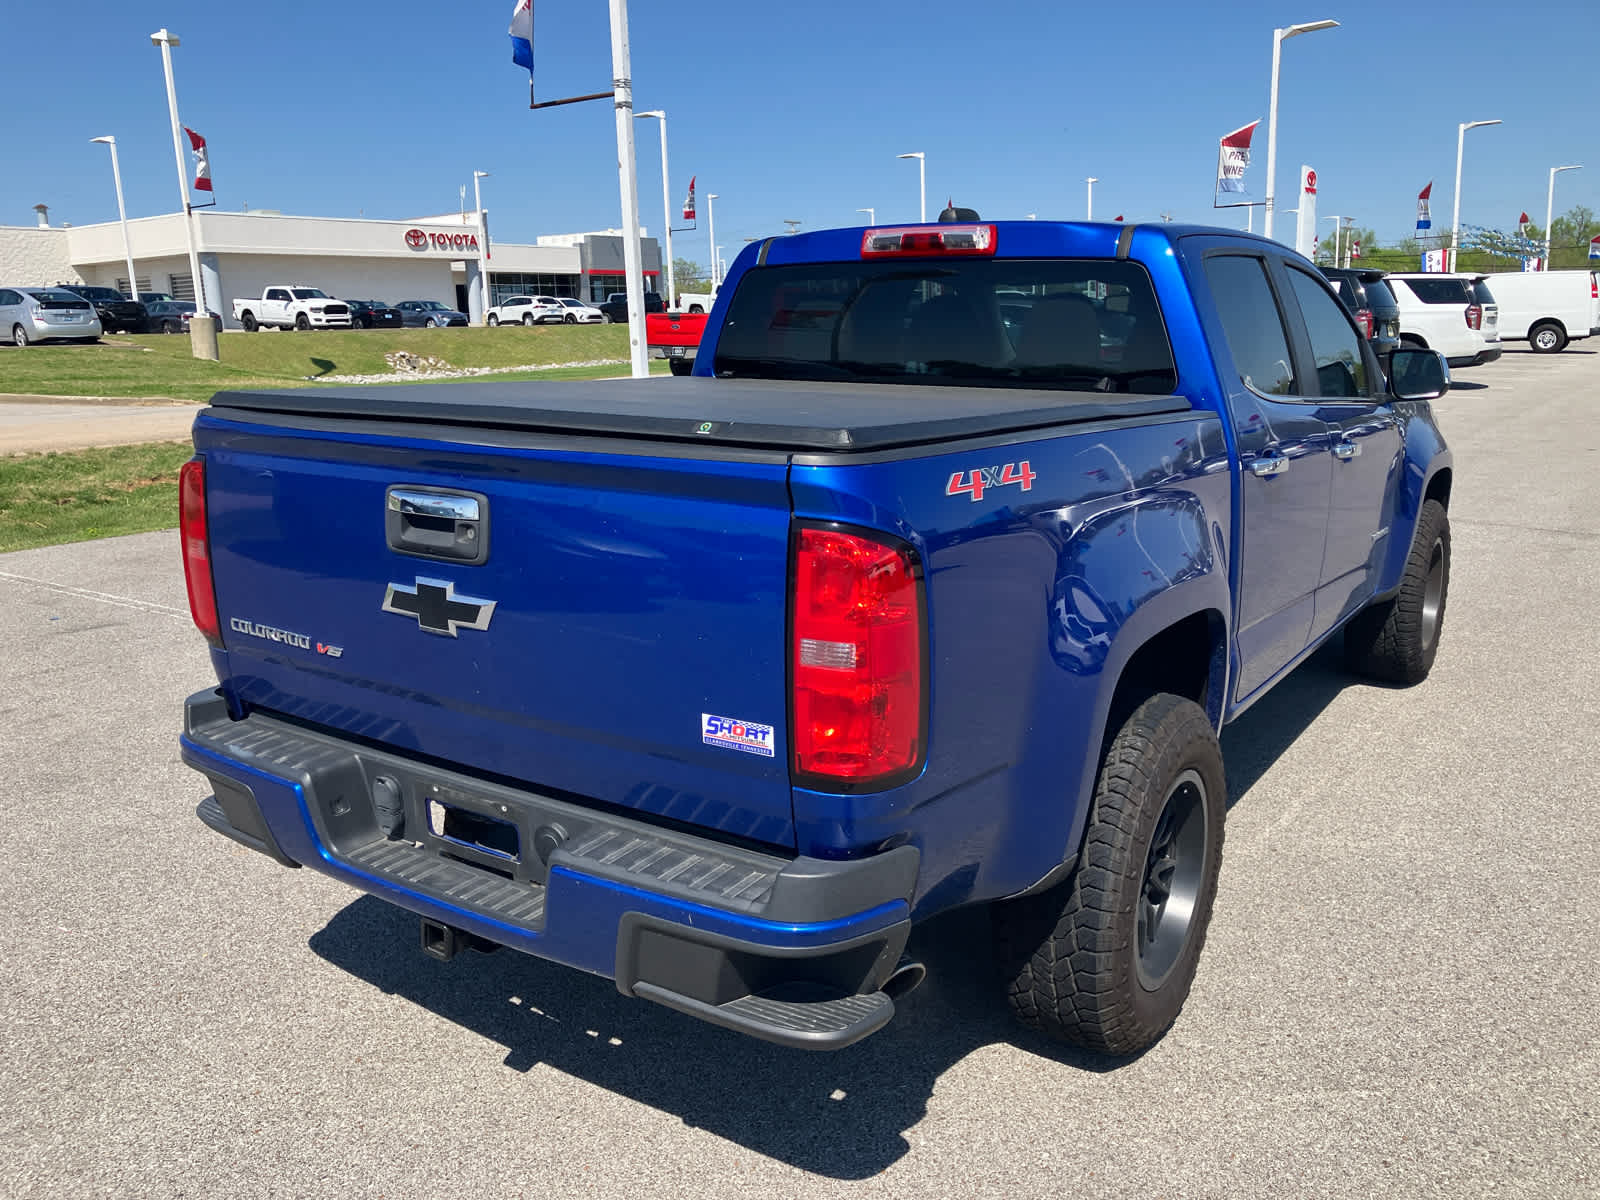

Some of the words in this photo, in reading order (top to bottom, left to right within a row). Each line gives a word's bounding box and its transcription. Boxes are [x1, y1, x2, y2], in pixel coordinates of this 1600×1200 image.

[429, 232, 479, 247] TOYOTA
[230, 617, 311, 650] COLORADO
[316, 642, 344, 657] V6
[705, 716, 770, 741] SHORT
